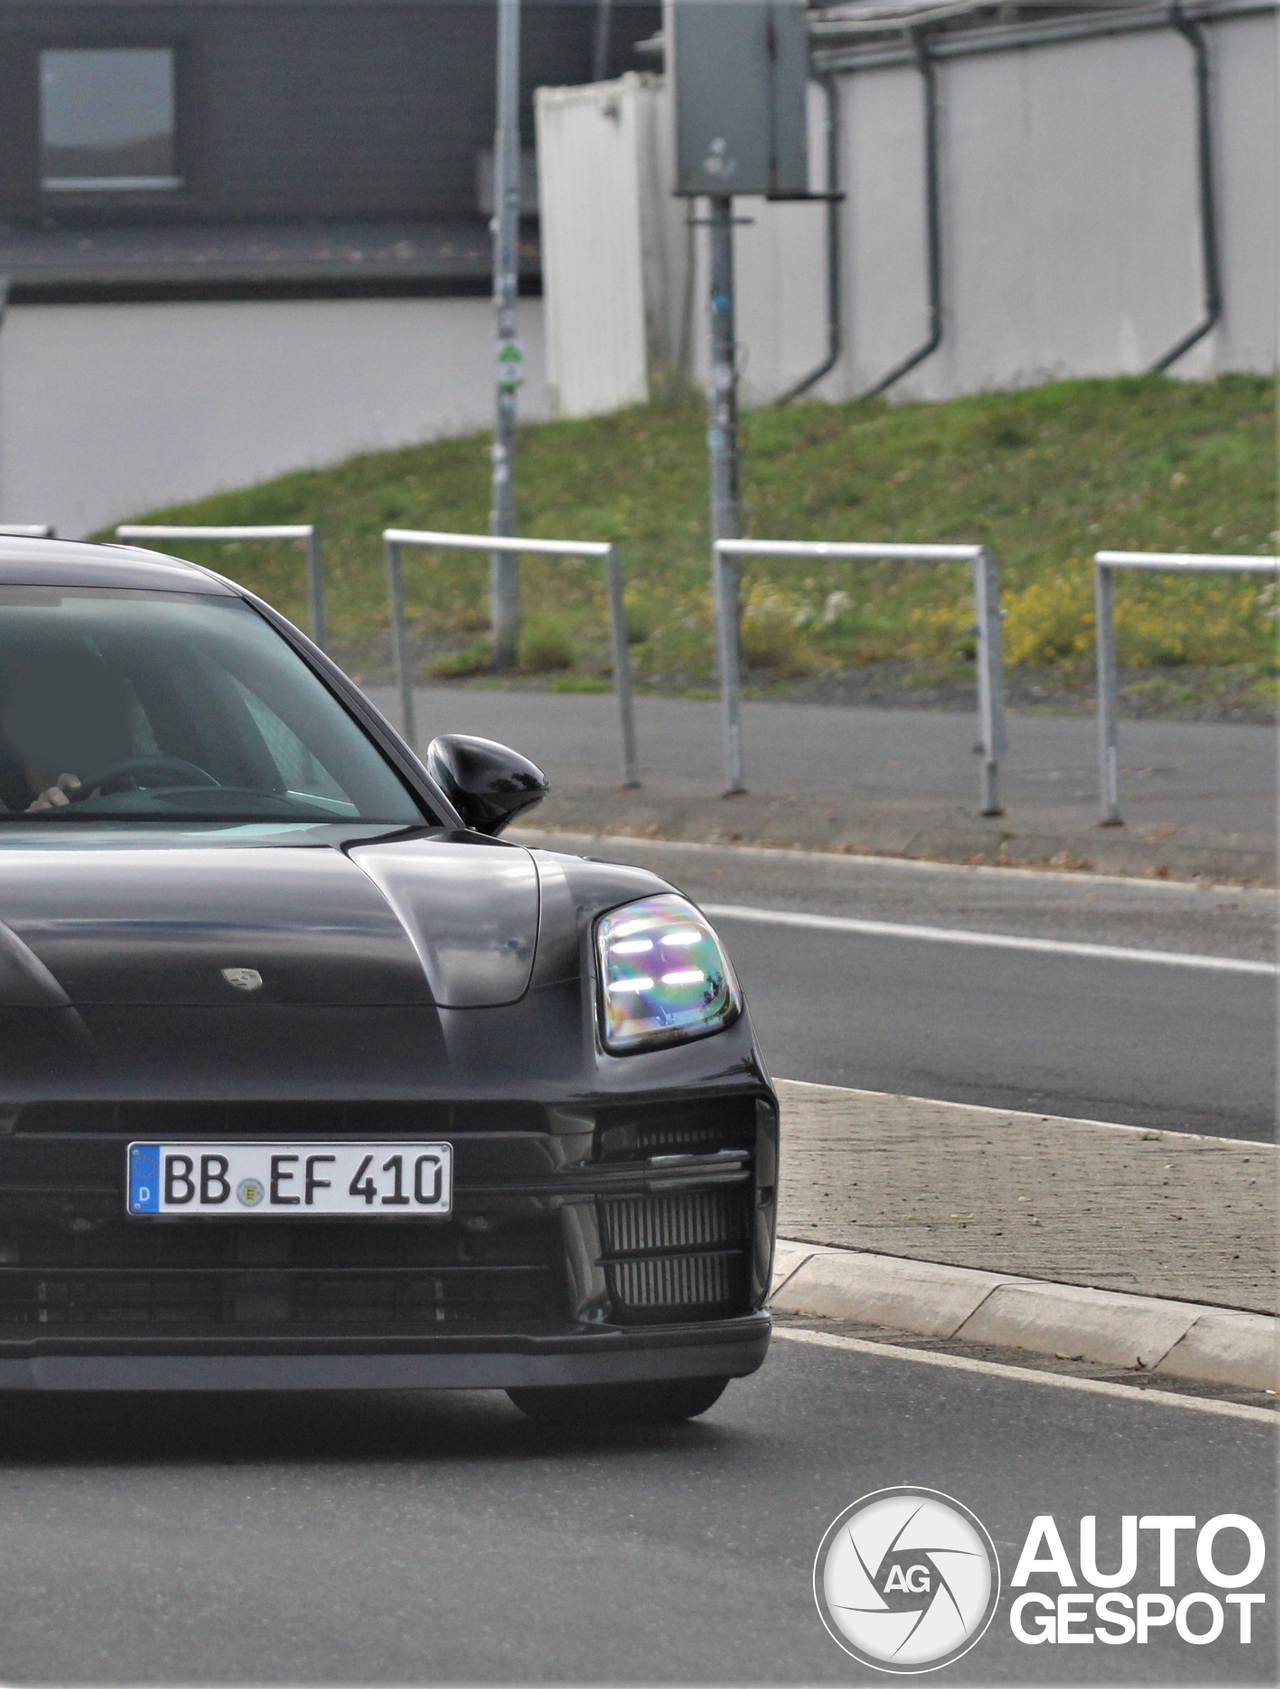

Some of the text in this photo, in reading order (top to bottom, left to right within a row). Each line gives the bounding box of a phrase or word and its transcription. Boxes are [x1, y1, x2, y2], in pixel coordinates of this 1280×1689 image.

[139, 1187, 150, 1200] D
[164, 1154, 443, 1204] BB EF 410
